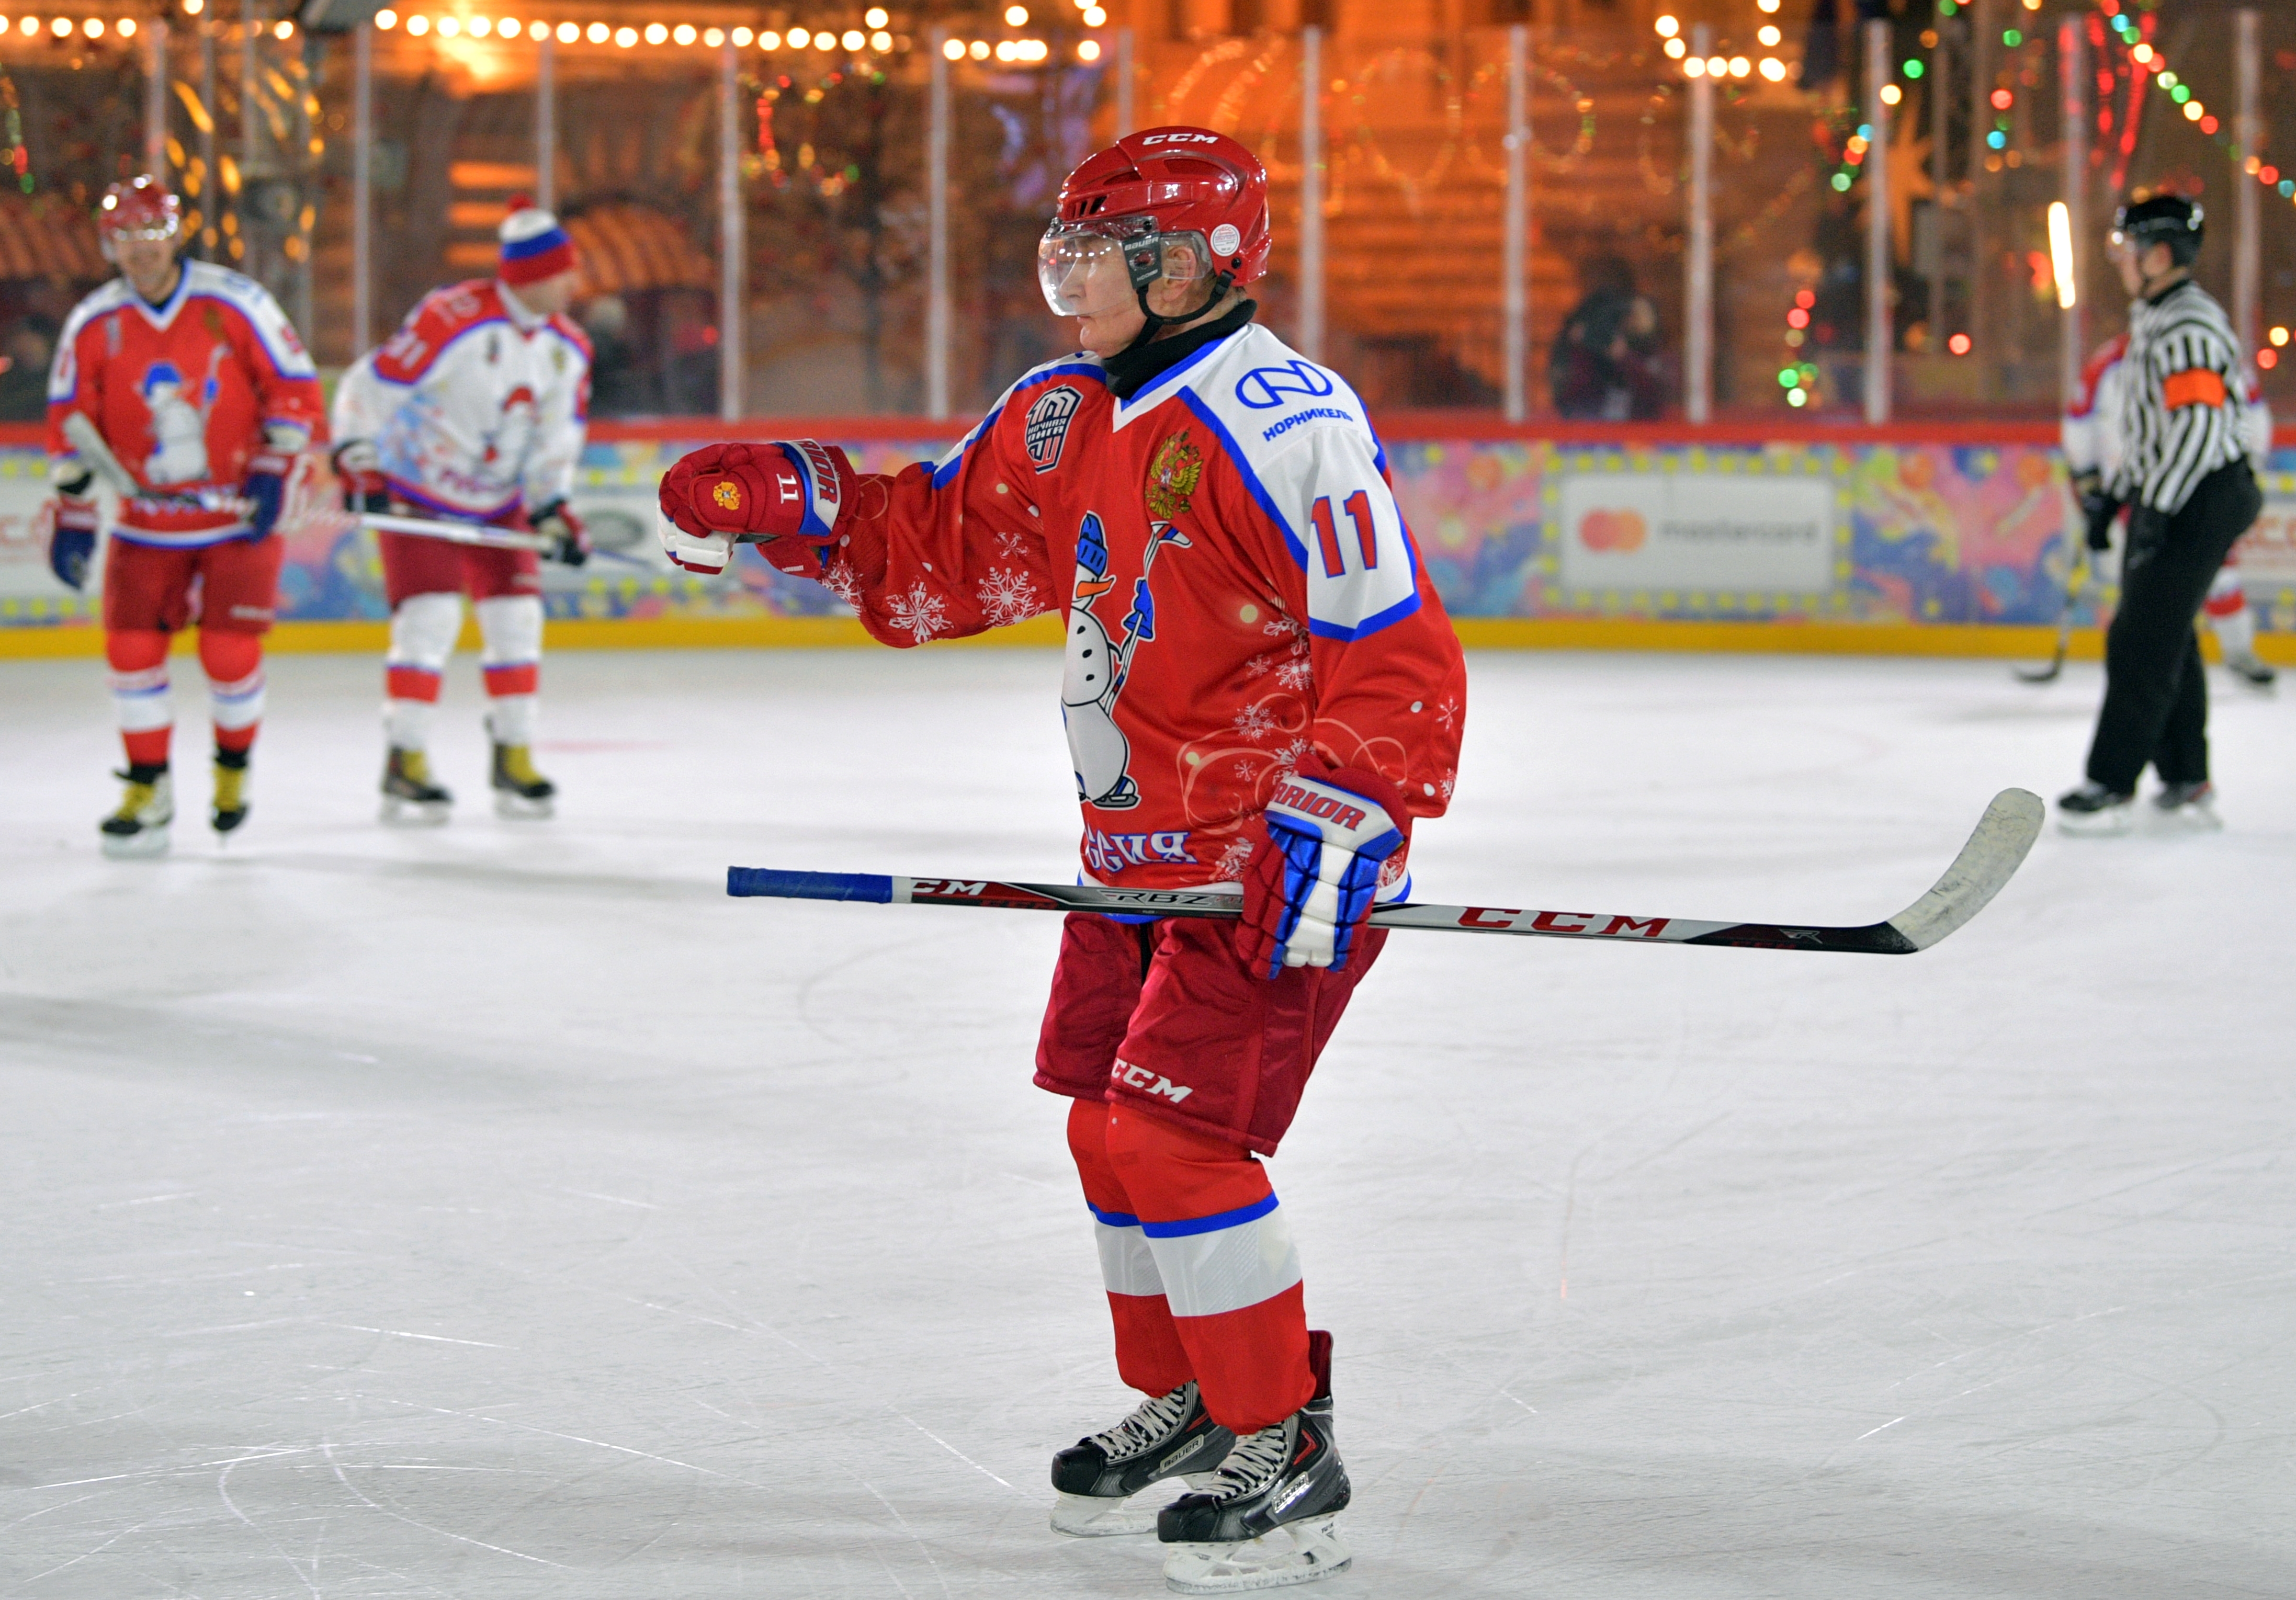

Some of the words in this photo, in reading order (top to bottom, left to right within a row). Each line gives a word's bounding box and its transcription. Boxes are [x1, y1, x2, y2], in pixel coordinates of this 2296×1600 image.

[1142, 133, 1219, 145] CCM
[1124, 236, 1159, 251] BAUER
[1027, 418, 1067, 435] НОЧНАЯ
[1027, 425, 1065, 444] ЛИГА
[1262, 408, 1354, 442] НОРНИКЕЛЬ
[776, 473, 799, 504] 11
[1311, 490, 1377, 578] 11
[1100, 890, 1211, 906] RBZ
[1458, 906, 1671, 937] CCM
[1112, 1058, 1194, 1104] CCM
[1164, 1439, 1199, 1468] BAUER
